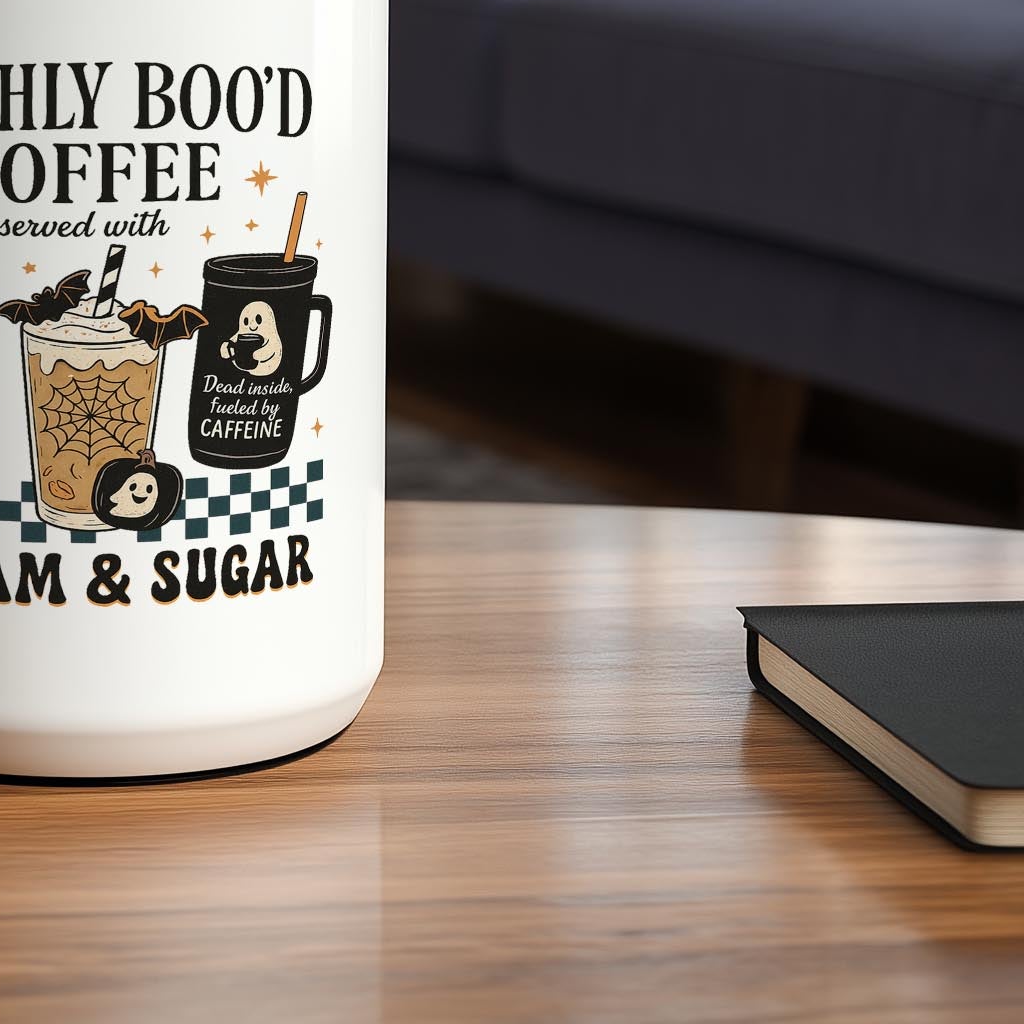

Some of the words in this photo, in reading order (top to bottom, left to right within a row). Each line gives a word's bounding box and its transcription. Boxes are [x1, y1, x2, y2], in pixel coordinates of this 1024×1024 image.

[103, 208, 171, 238] with
[202, 374, 246, 395] Dead
[247, 376, 293, 396] inside,
[209, 396, 259, 416] fueled
[260, 398, 281, 422] by
[200, 418, 283, 440] CAFFEINE
[85, 552, 131, 606] &
[150, 533, 314, 606] SUGAR
